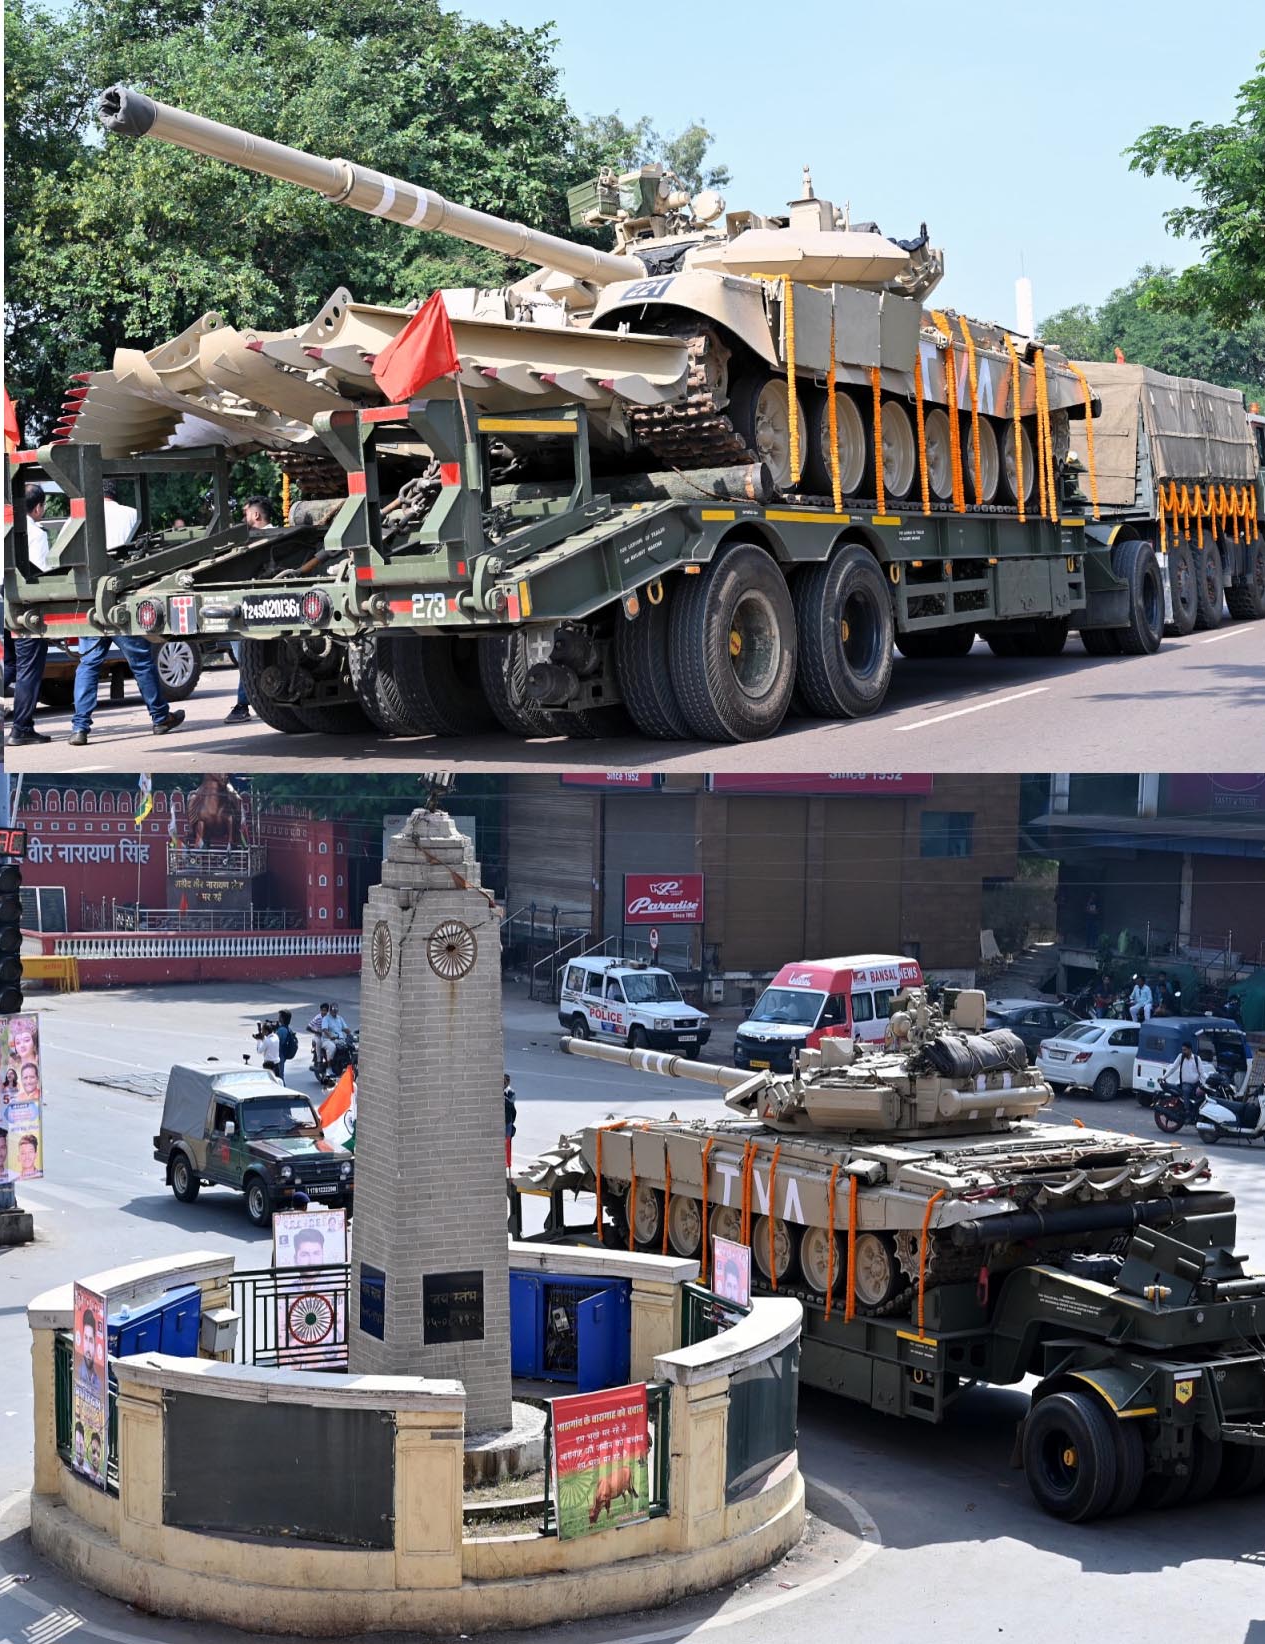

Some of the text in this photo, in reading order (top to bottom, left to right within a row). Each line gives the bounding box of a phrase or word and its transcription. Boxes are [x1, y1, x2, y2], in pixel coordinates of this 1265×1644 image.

[626, 279, 669, 298] 221
[411, 592, 446, 619] 273
[27, 837, 53, 864] वीर
[56, 843, 116, 864] नारायण
[118, 838, 150, 864] सिंह
[627, 896, 699, 914] Paradise
[869, 966, 918, 984] BANSAL NEWS
[589, 1007, 623, 1024] POLICE
[584, 1414, 591, 1425] के
[616, 1406, 626, 1418] को
